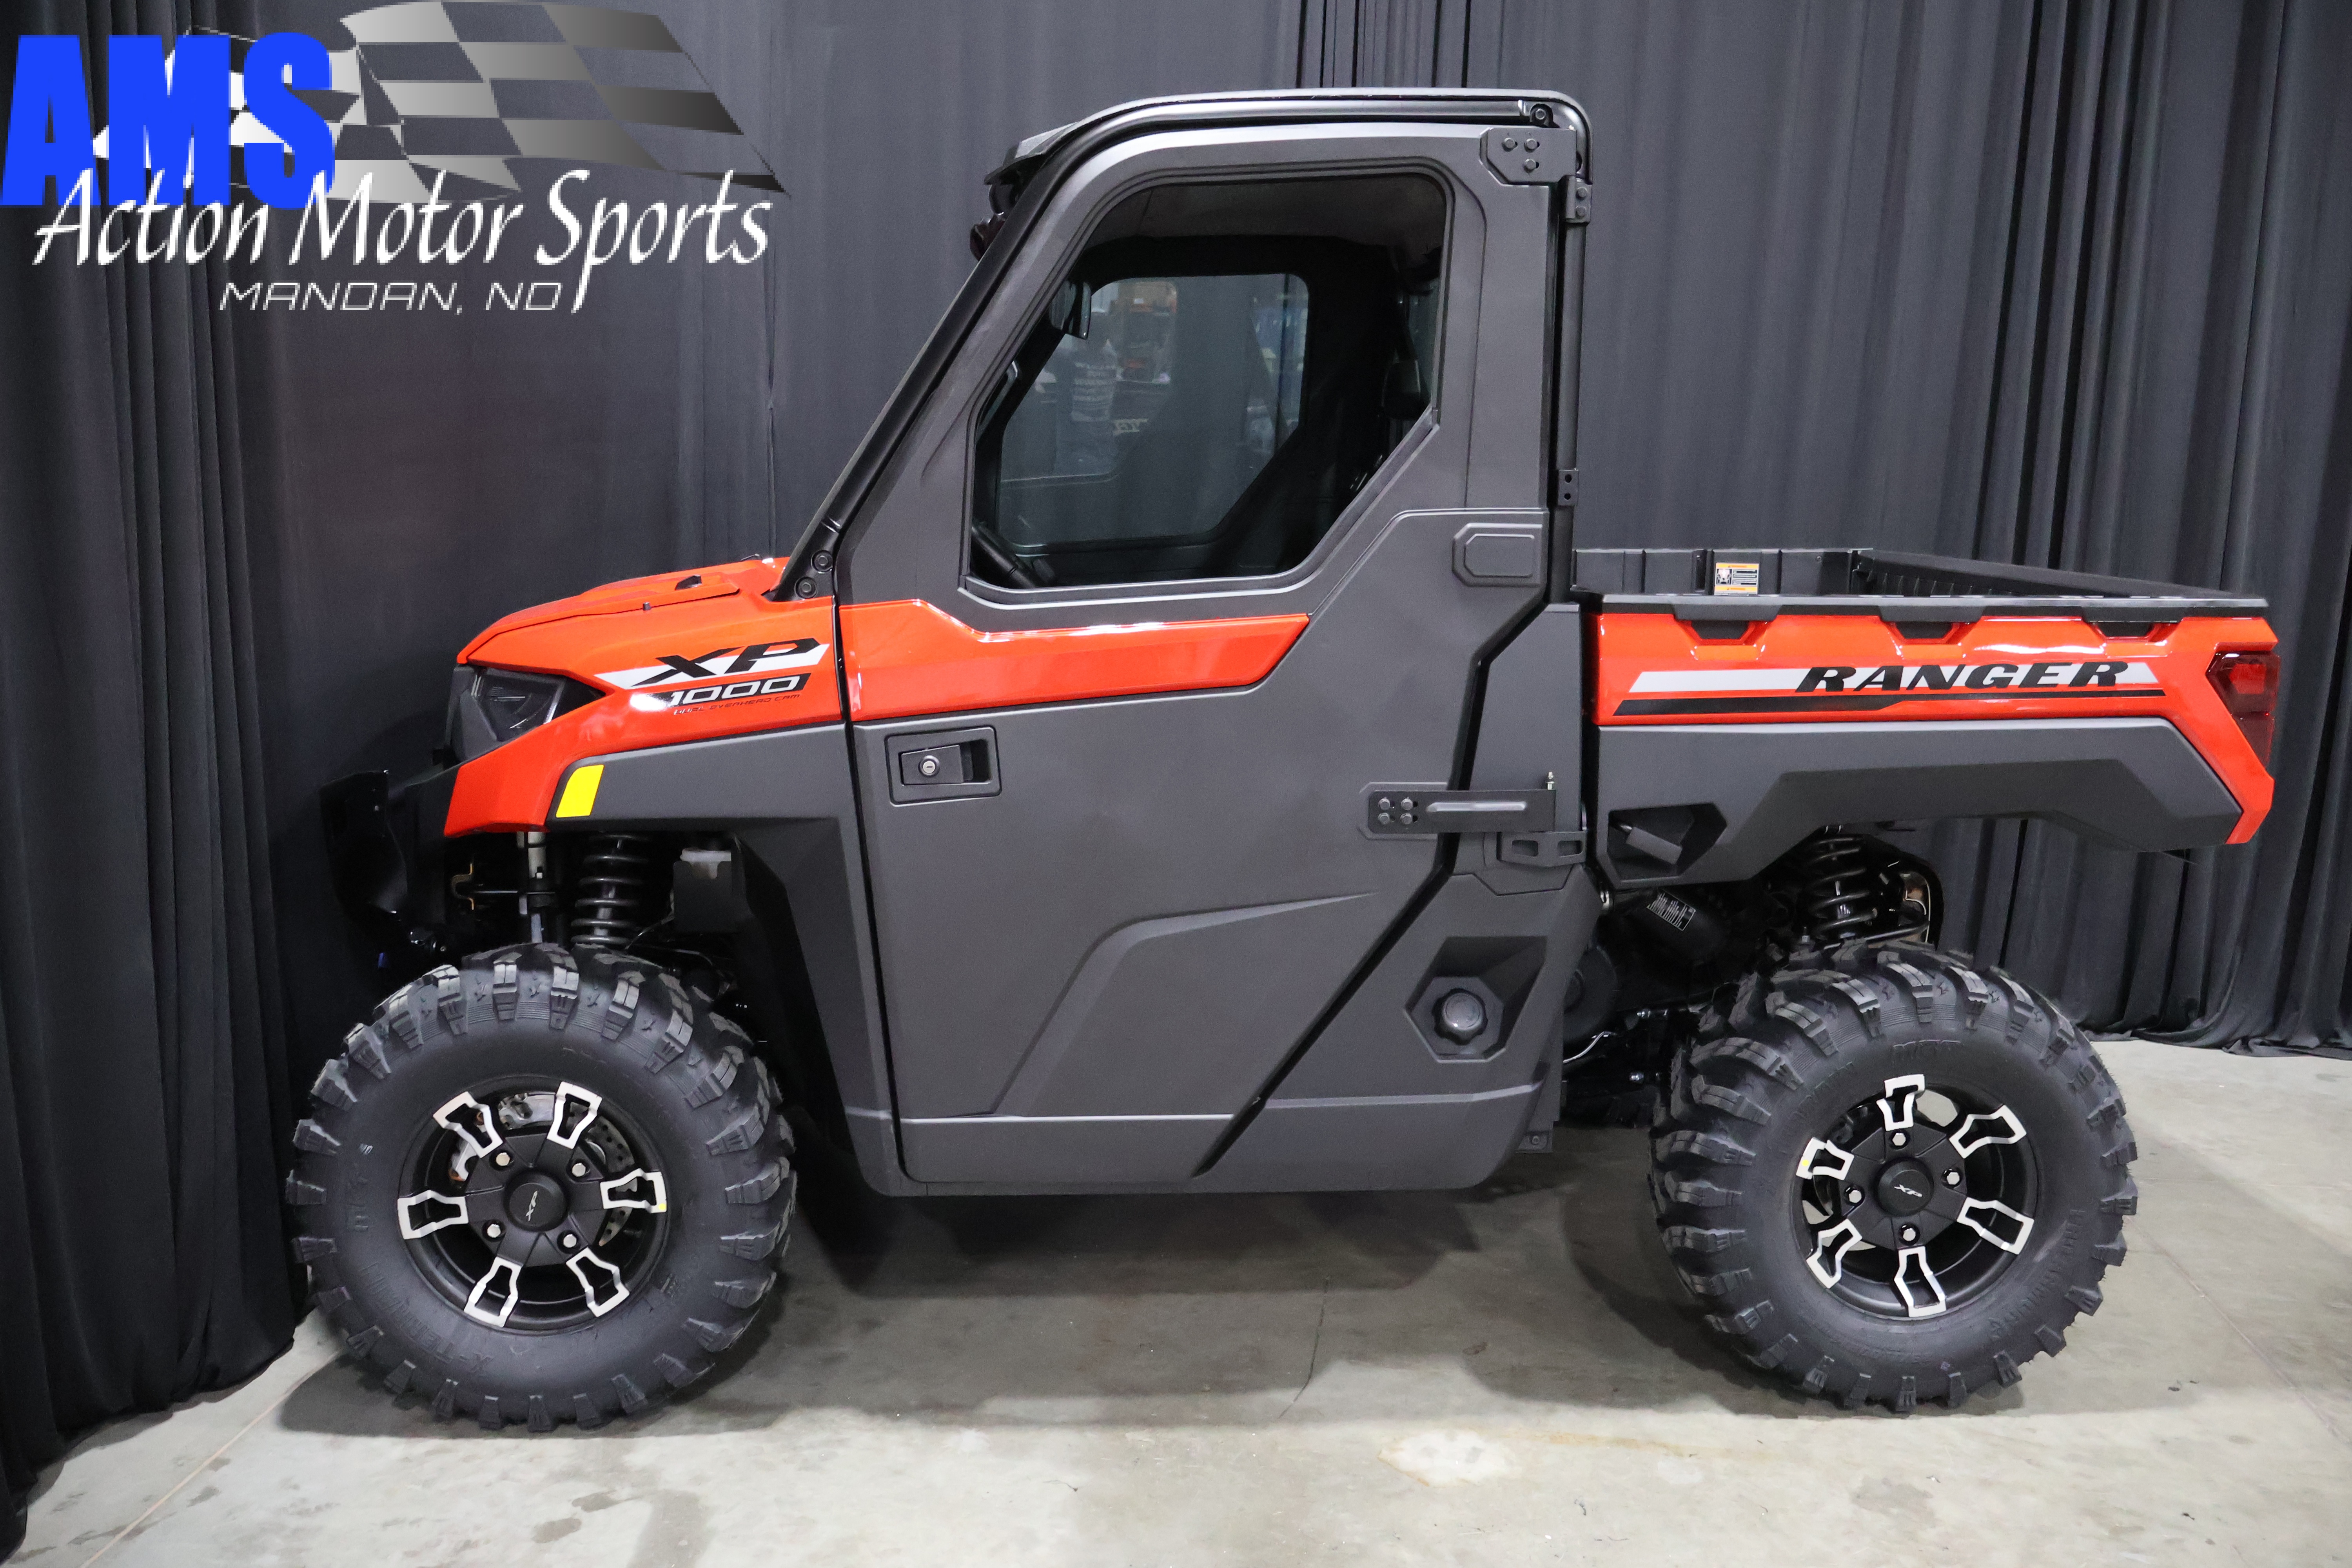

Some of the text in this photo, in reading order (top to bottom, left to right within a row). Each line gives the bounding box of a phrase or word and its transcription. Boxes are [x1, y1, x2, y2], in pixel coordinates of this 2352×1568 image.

[630, 637, 821, 688] XP
[1794, 661, 2129, 693] RANGER
[671, 675, 800, 706] 1000
[673, 693, 800, 715] DUAL OVERHEAD CAM
